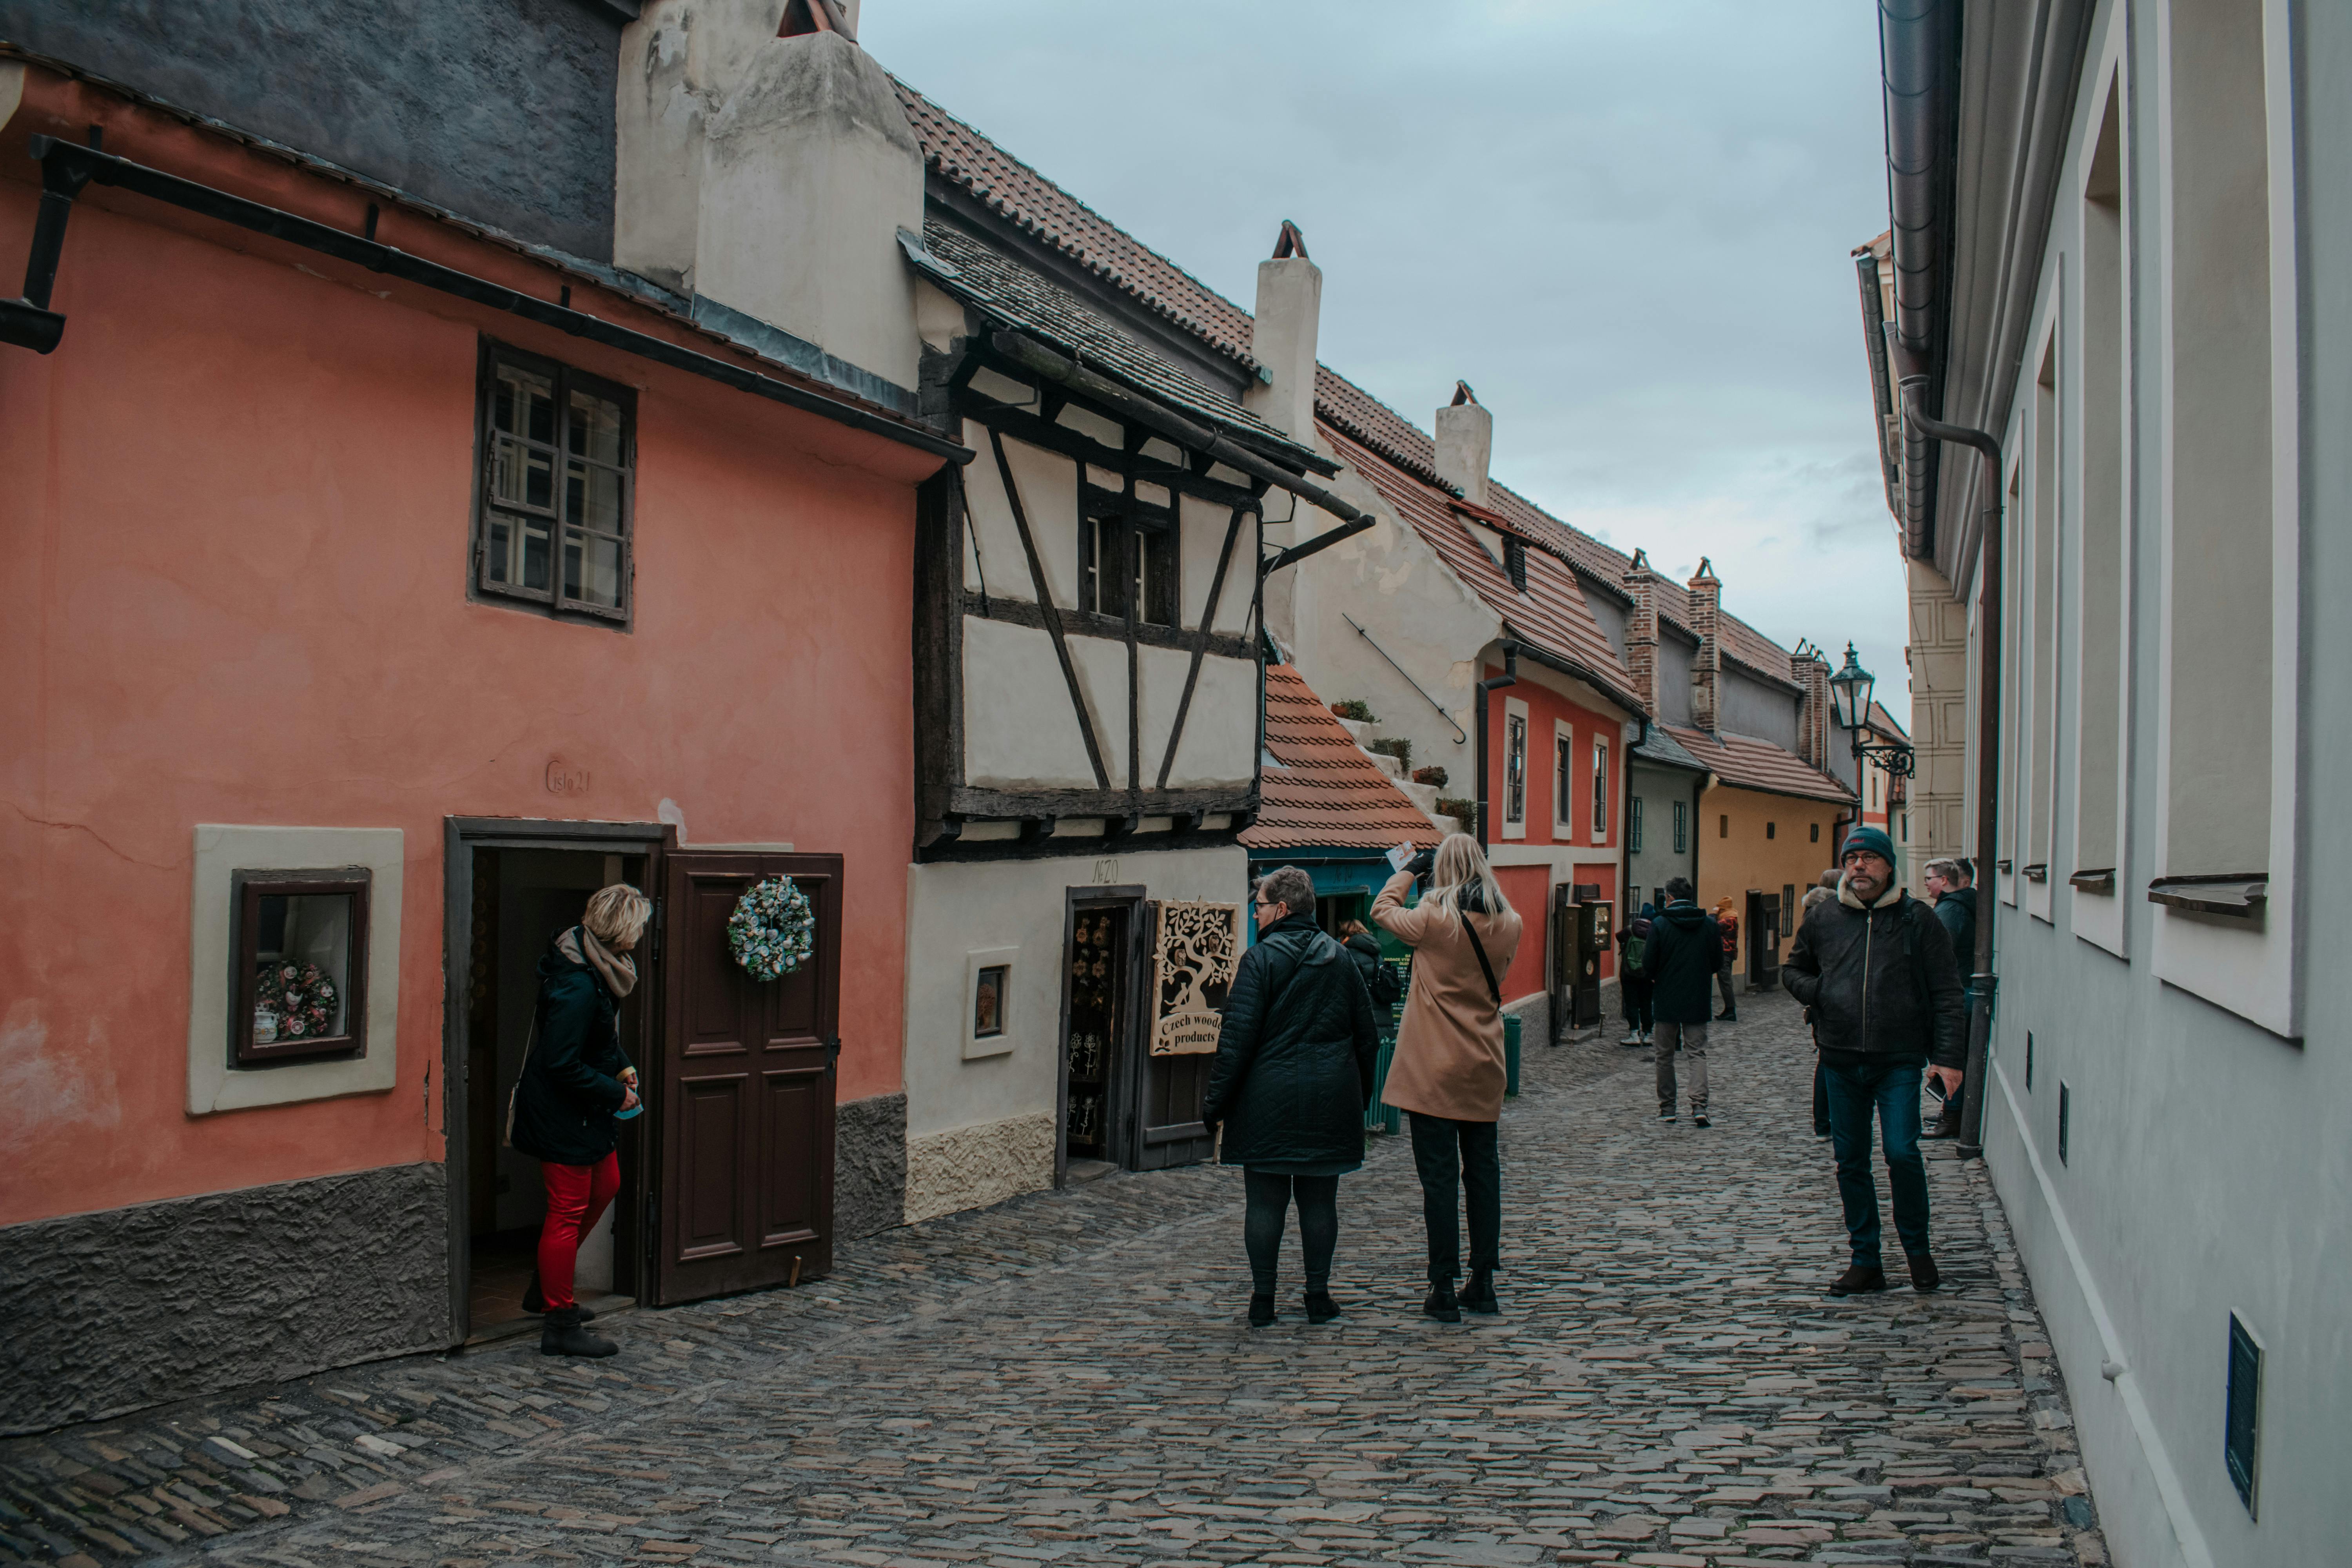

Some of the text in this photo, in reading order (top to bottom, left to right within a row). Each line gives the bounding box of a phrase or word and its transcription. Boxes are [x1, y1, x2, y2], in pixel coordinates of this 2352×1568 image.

[576, 771, 590, 792] 21
[1162, 1014, 1191, 1035] Czech
[1175, 1031, 1215, 1047] products
